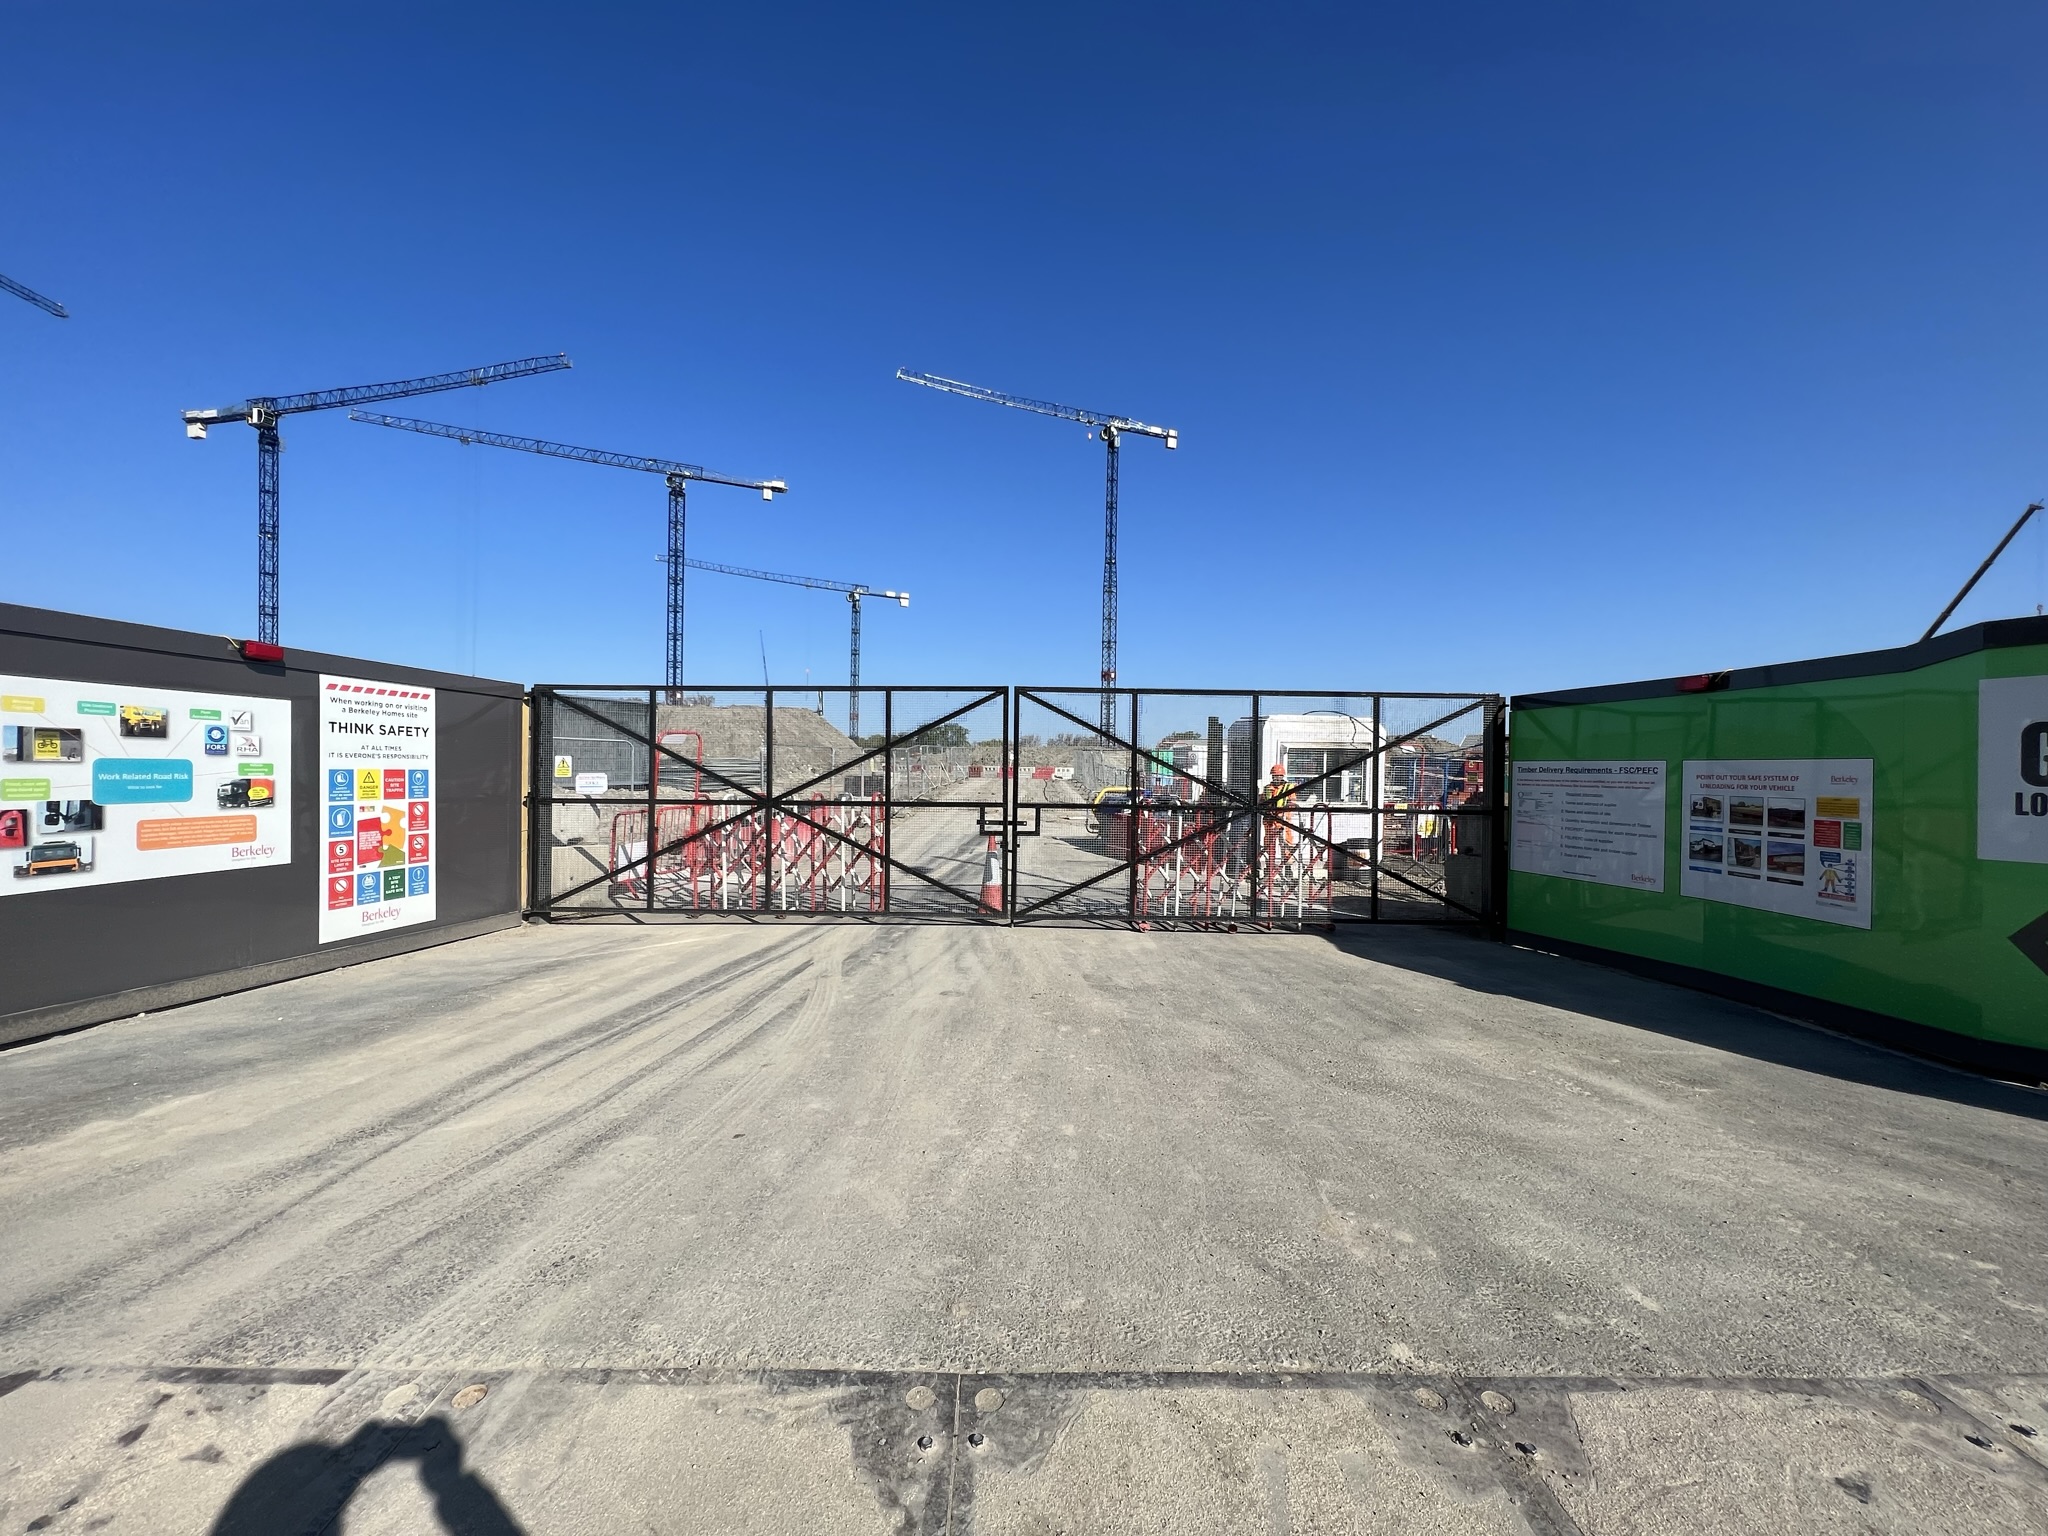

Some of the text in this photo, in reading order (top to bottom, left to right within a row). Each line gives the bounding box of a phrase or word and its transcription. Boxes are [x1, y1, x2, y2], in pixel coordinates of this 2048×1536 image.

[354, 701, 383, 709] working
[405, 704, 428, 712] visiting
[349, 707, 381, 716] Berkeley
[382, 710, 405, 718] Homes
[328, 721, 430, 738] THINK SAFETY
[1566, 767, 1612, 775] Requirements
[1619, 767, 1659, 775] FSC/PEFC
[1830, 775, 1858, 784] Berkeley
[231, 845, 275, 858] Berkeley
[1631, 874, 1656, 884] Berkeley
[362, 906, 402, 922] Berkeley
